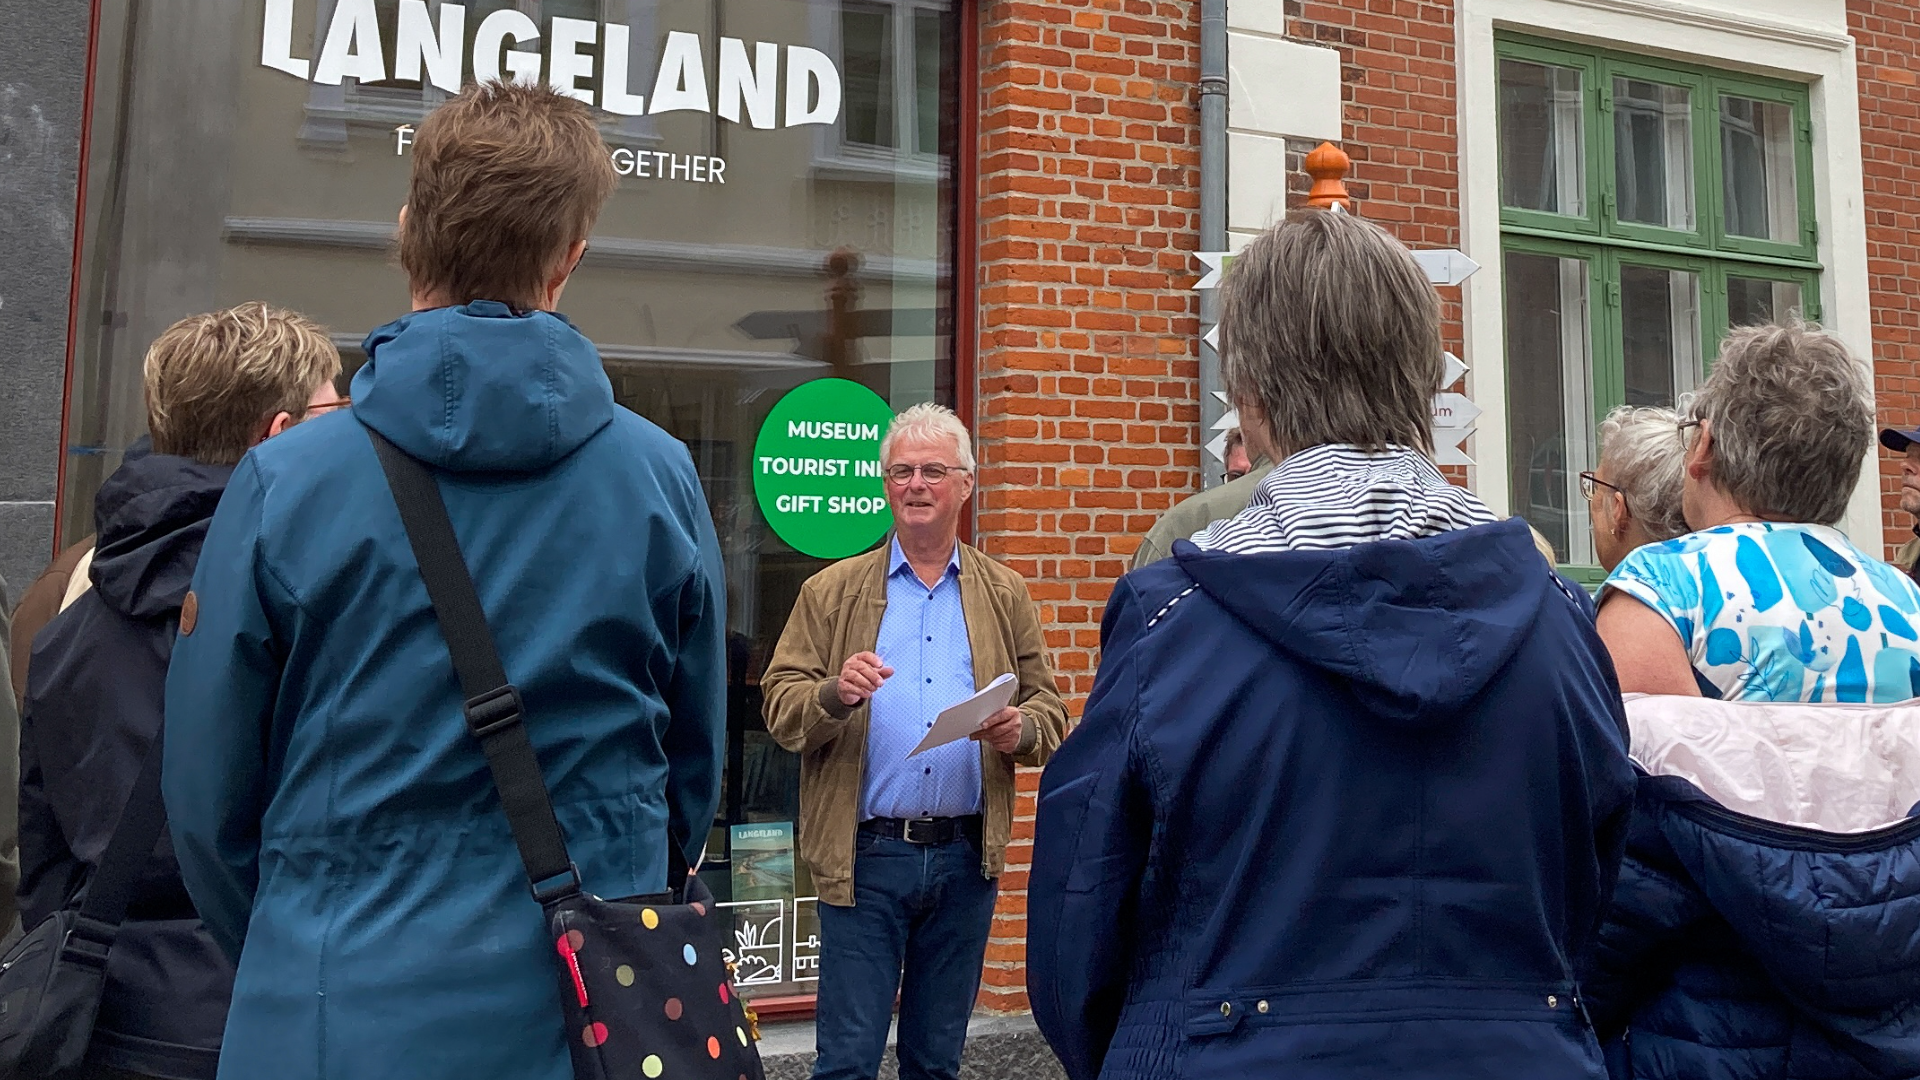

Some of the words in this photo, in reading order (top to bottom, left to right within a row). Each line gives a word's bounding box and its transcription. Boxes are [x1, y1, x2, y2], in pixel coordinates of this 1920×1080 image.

[261, 0, 841, 129] LANGELAND
[610, 147, 727, 184] GETHER
[788, 420, 879, 441] MUSEUM
[759, 456, 850, 477] TOURIST
[775, 494, 824, 514] GIFT
[827, 496, 887, 515] SHOP
[738, 829, 783, 839] LANGELAND
